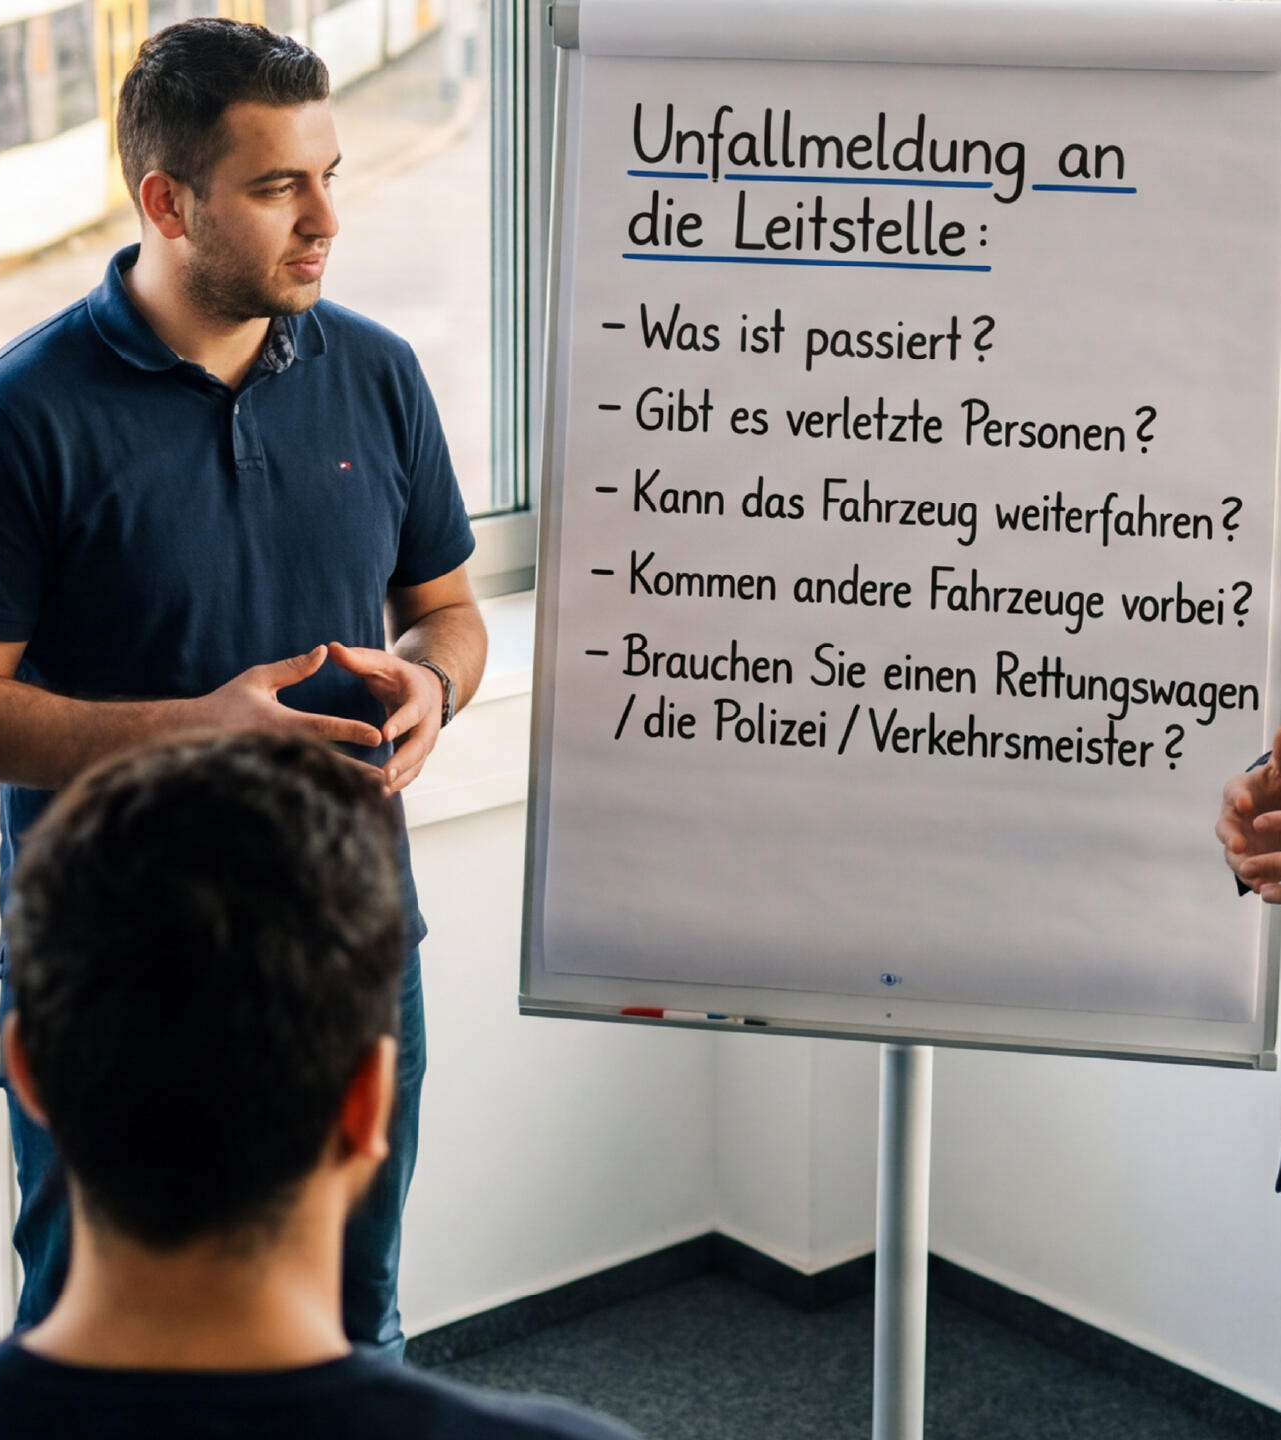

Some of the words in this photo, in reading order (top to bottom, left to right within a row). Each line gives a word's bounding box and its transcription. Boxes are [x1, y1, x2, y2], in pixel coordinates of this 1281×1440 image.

[633, 102, 1025, 204] Unfallmeldung
[1058, 143, 1125, 180] an
[628, 189, 704, 248] die
[735, 190, 988, 257] Leitstelle:
[640, 303, 721, 352] Was
[740, 308, 785, 354] ist
[805, 314, 995, 372] passiert?
[636, 386, 714, 433] Gibt
[730, 407, 769, 436] es
[786, 395, 943, 444] verletzte
[960, 398, 1157, 454] Personen?
[633, 468, 724, 516] Kann
[741, 475, 805, 520] das
[822, 477, 977, 547] Fahrzeug
[995, 491, 1243, 547] weiterfahren?
[630, 550, 776, 601] Kommen
[793, 563, 912, 609] andere
[930, 565, 1104, 635] Fahrzeuge
[1121, 580, 1253, 628] vorbei?
[622, 632, 793, 685] Brauchen
[810, 642, 866, 689] Sie
[883, 654, 976, 694] einen
[996, 650, 1259, 726] Rettungswagen
[643, 694, 697, 740] die
[713, 698, 827, 748] Polizei
